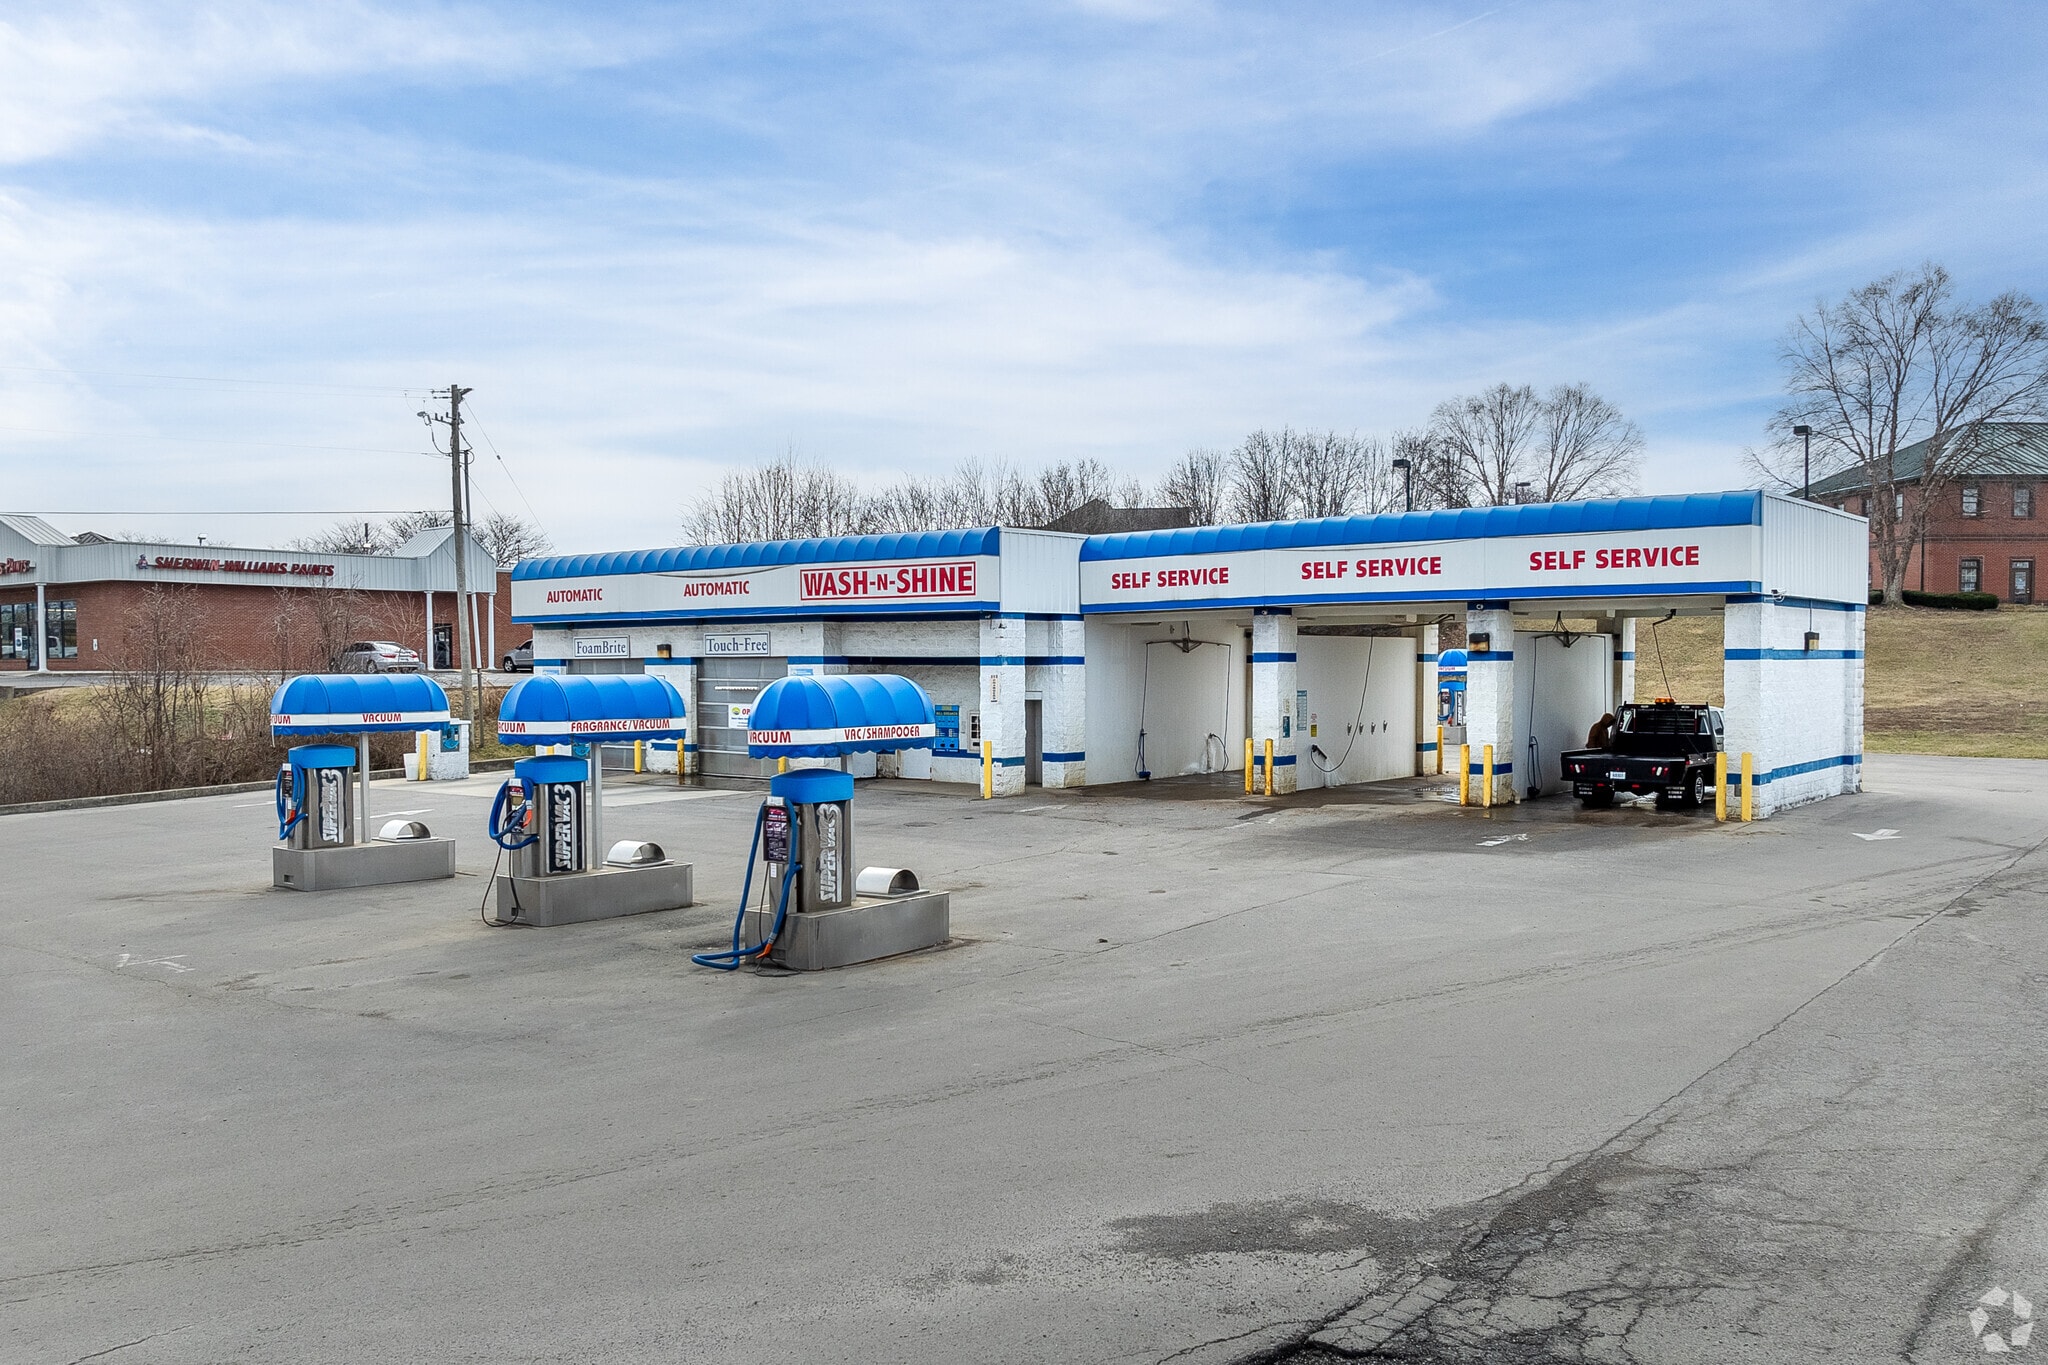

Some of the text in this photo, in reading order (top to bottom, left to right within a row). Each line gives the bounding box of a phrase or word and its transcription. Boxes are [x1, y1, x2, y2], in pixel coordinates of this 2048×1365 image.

[1529, 546, 1699, 571] SELF SERVICE
[291, 564, 335, 576] PAINTS
[1301, 556, 1442, 580] SELF SERVICE
[803, 566, 973, 597] WASH-N-SHINE
[1111, 567, 1229, 589] SELF SERVICE
[546, 588, 603, 604] AUTOMATIC
[683, 580, 750, 597] AUTOMATIC
[576, 640, 626, 654] FoamBrite
[706, 637, 768, 652] Touch-Free
[362, 713, 402, 723] VACUUM
[571, 718, 671, 733] FRAGRANCE/VACUUM
[844, 725, 920, 741] VAC/SHAMPOOER
